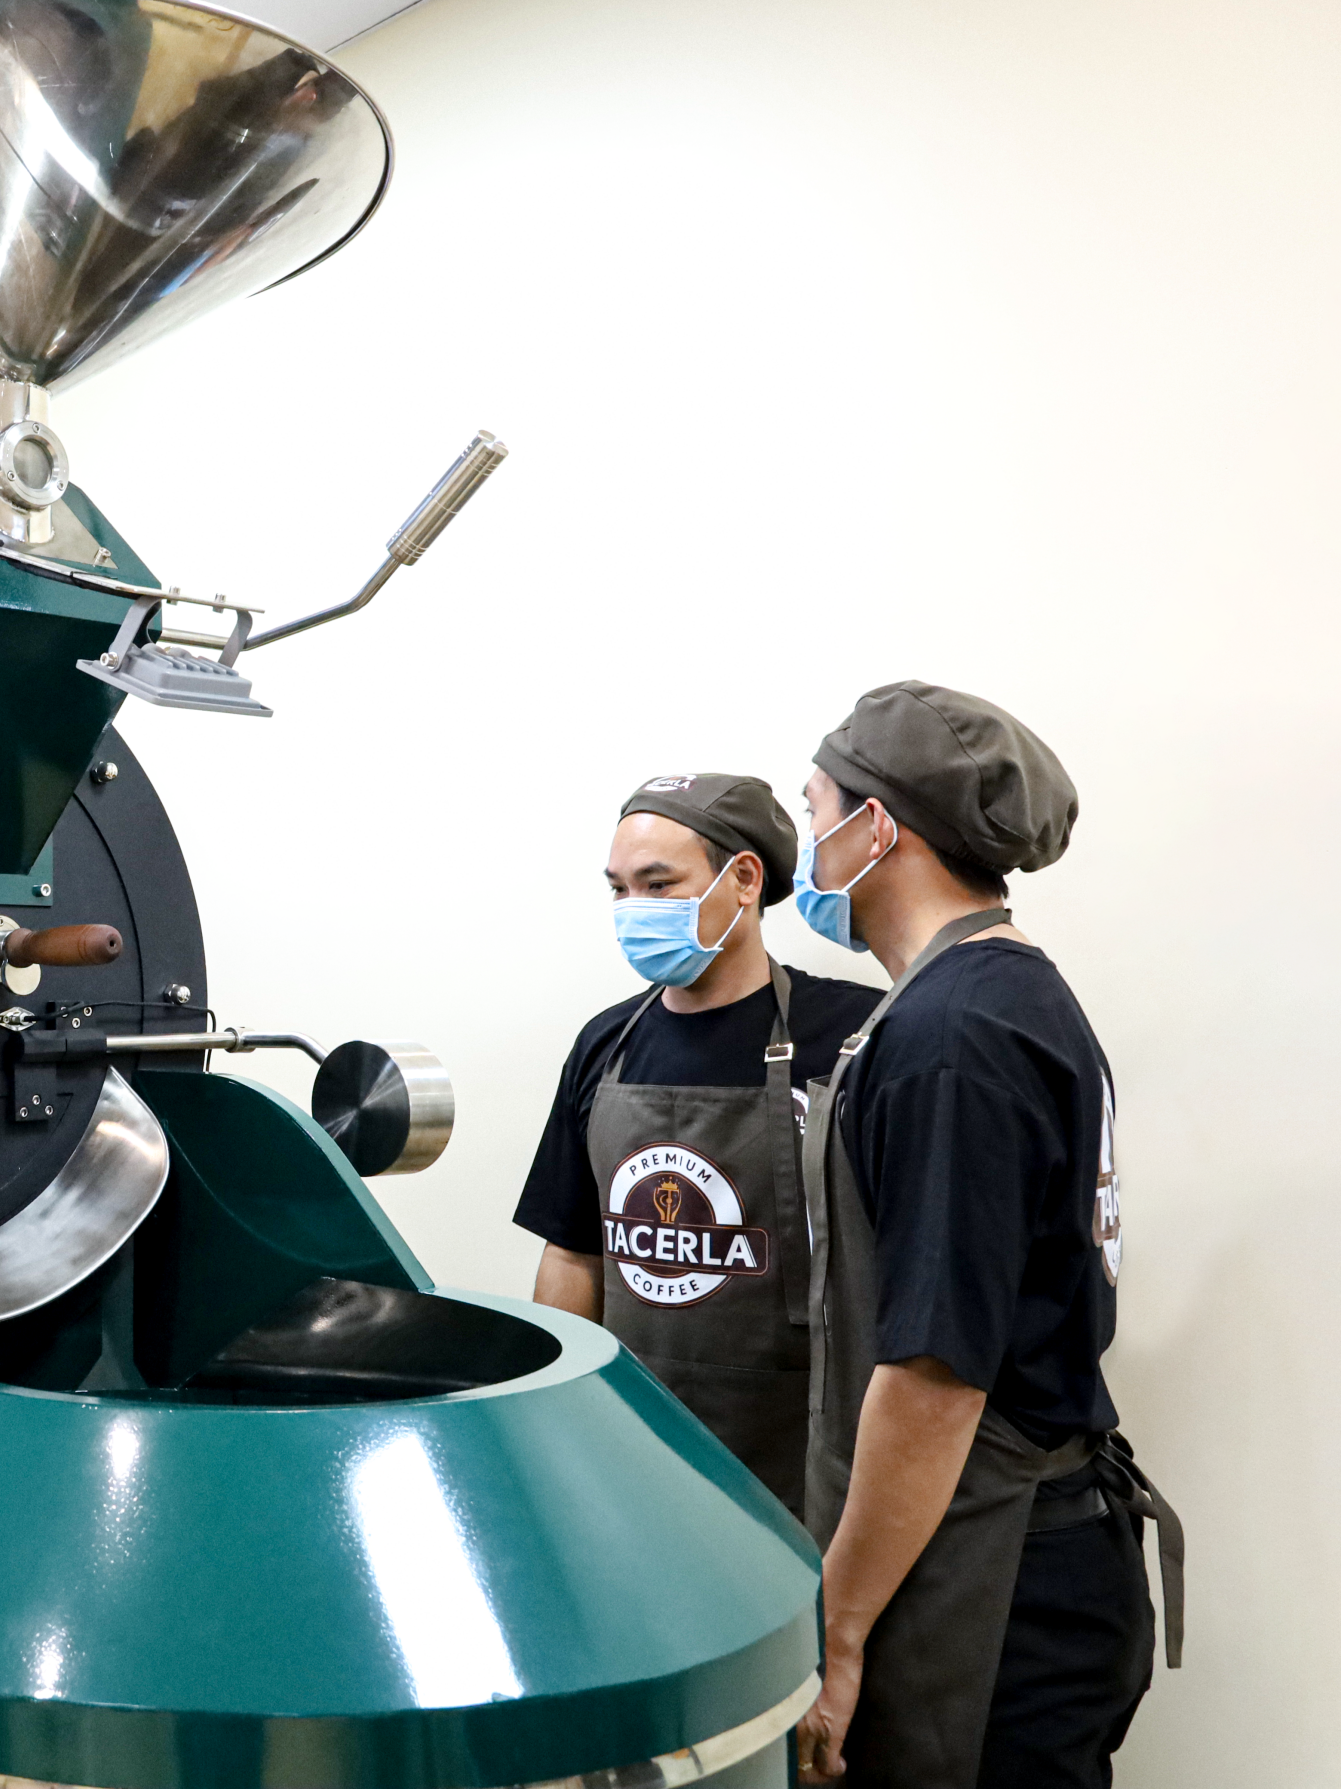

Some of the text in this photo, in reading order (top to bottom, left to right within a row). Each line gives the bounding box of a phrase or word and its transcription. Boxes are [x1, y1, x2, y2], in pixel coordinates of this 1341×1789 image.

[629, 1153, 712, 1184] PREMIUM
[604, 1220, 758, 1268] TACERLA
[633, 1273, 700, 1297] COFFEE
